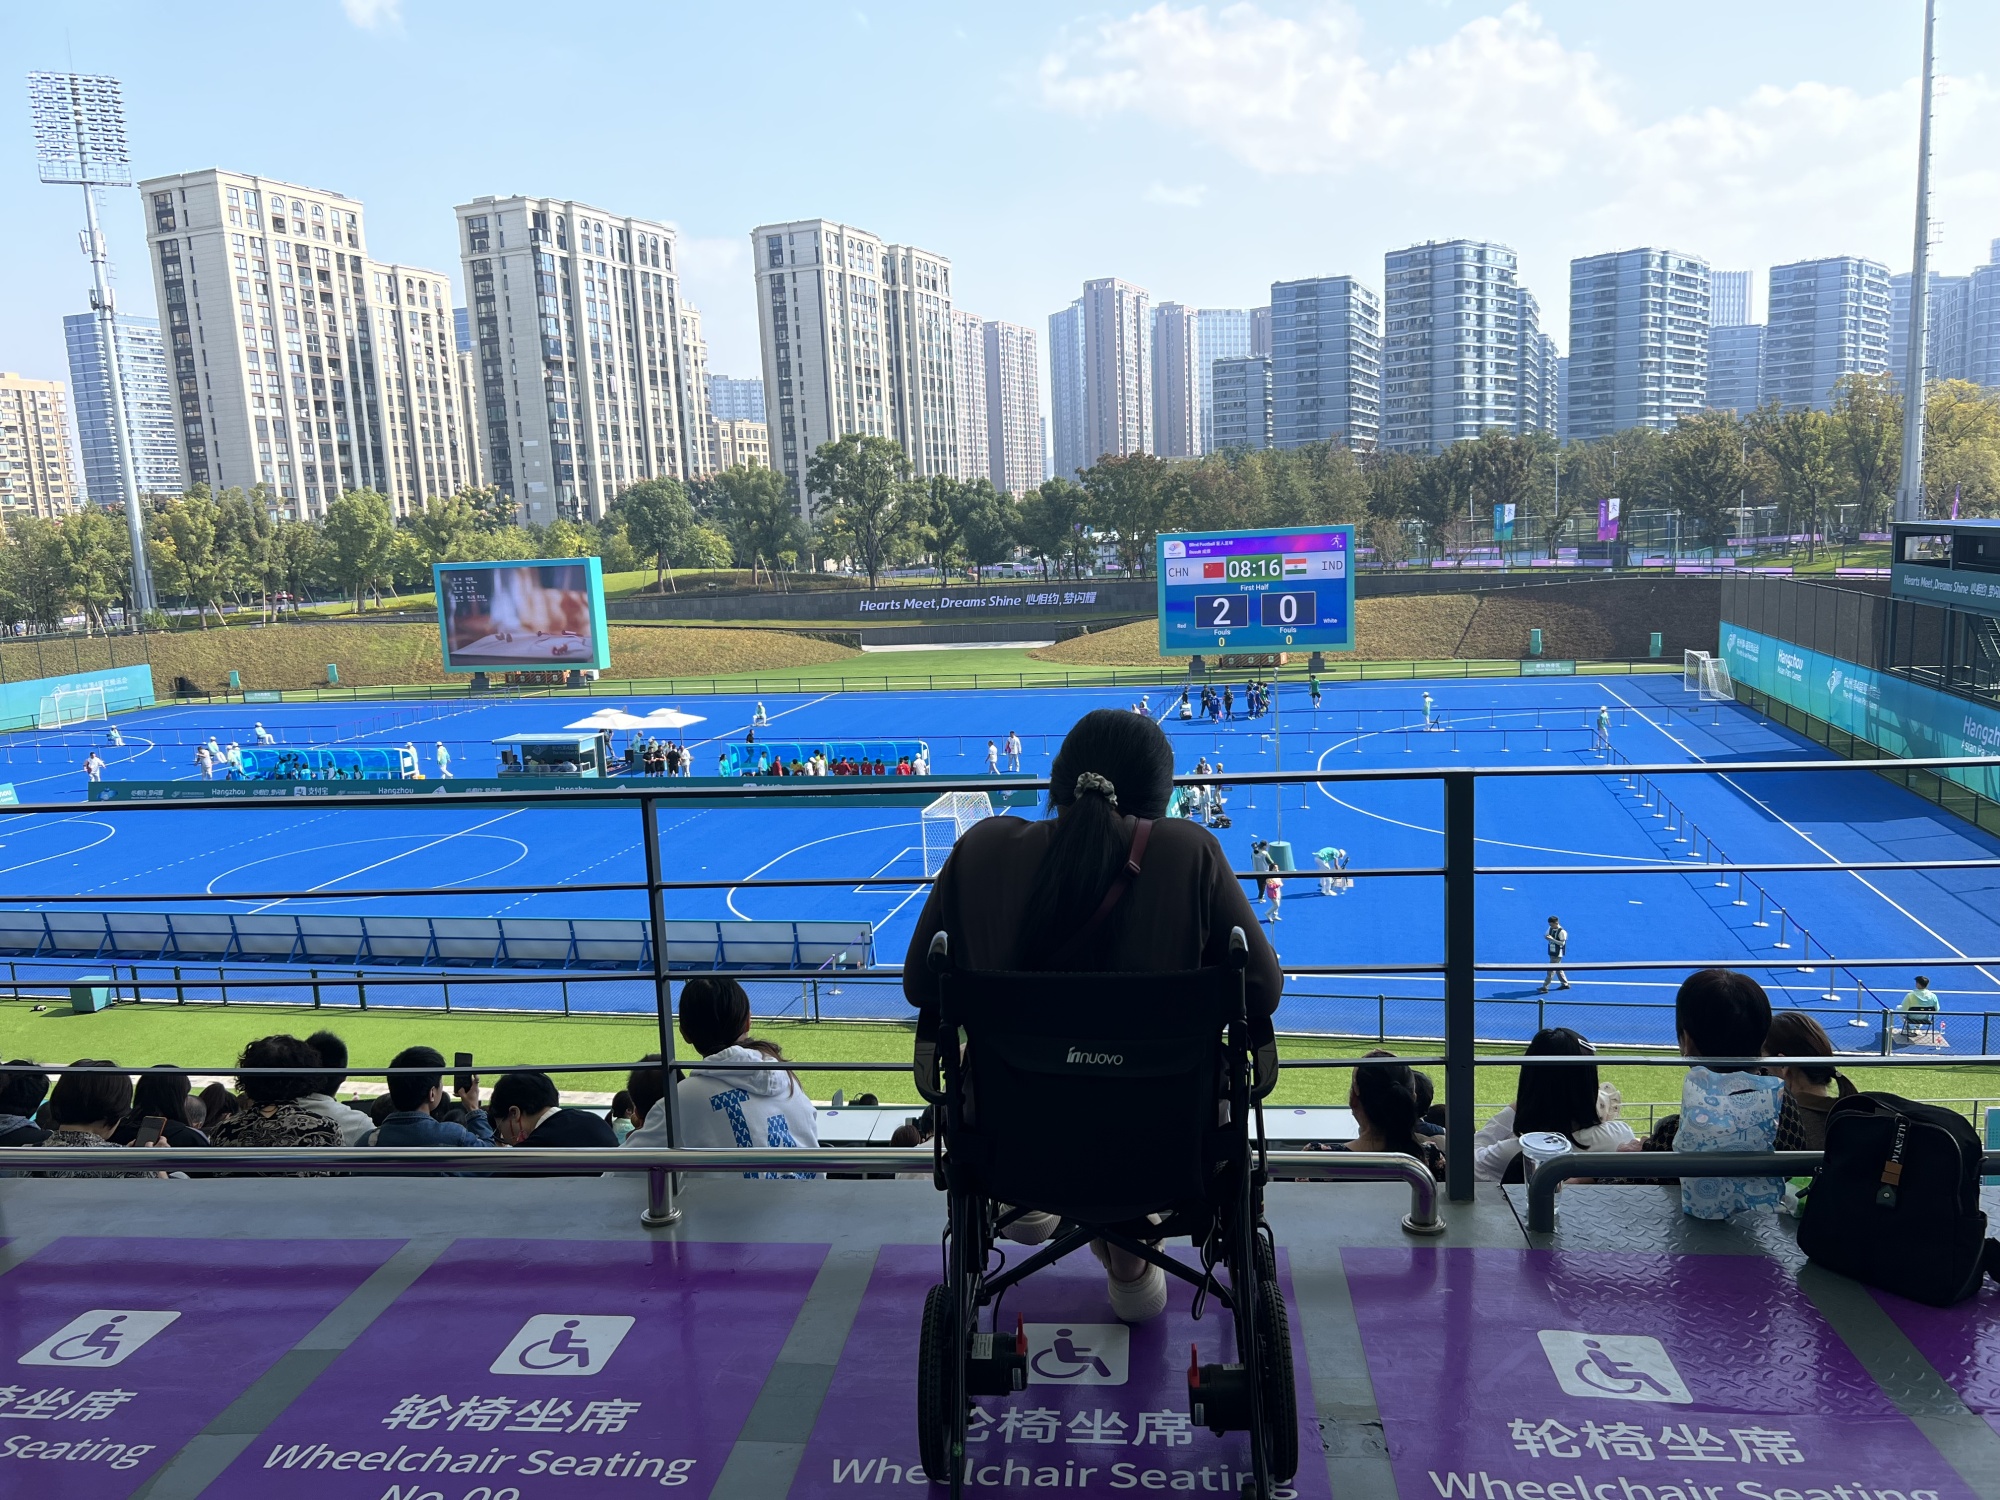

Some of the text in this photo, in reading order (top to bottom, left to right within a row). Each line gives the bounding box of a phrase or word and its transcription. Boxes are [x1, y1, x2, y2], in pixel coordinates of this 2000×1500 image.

[1168, 567, 1189, 577] CHN
[1229, 559, 1280, 578] 08:16
[1321, 560, 1343, 571] IND
[1256, 583, 1269, 591] Half
[1903, 574, 1920, 587] Hearts
[1953, 581, 1969, 594] Shine
[859, 599, 901, 611] Hearts
[988, 595, 1021, 607] Shine
[1212, 597, 1231, 625] 2
[1279, 595, 1297, 623] 0
[1213, 628, 1231, 636] Fouls
[1279, 626, 1297, 634] Fouls
[1218, 637, 1225, 647] 0
[1286, 635, 1293, 645] 0
[1778, 648, 1804, 670] Hangzhou
[1961, 739, 1976, 754] Asian
[211, 788, 246, 797] Hangzhou
[378, 786, 414, 795] Hangzhou
[381, 1394, 642, 1435] 轮椅坐席
[1507, 1417, 1805, 1467] 轮椅坐席
[0, 1435, 156, 1470] Seating
[263, 1443, 696, 1486] Wheelchair Seating
[833, 1458, 1098, 1488] Whelchair
[1428, 1470, 1723, 1500] Wheelchair
